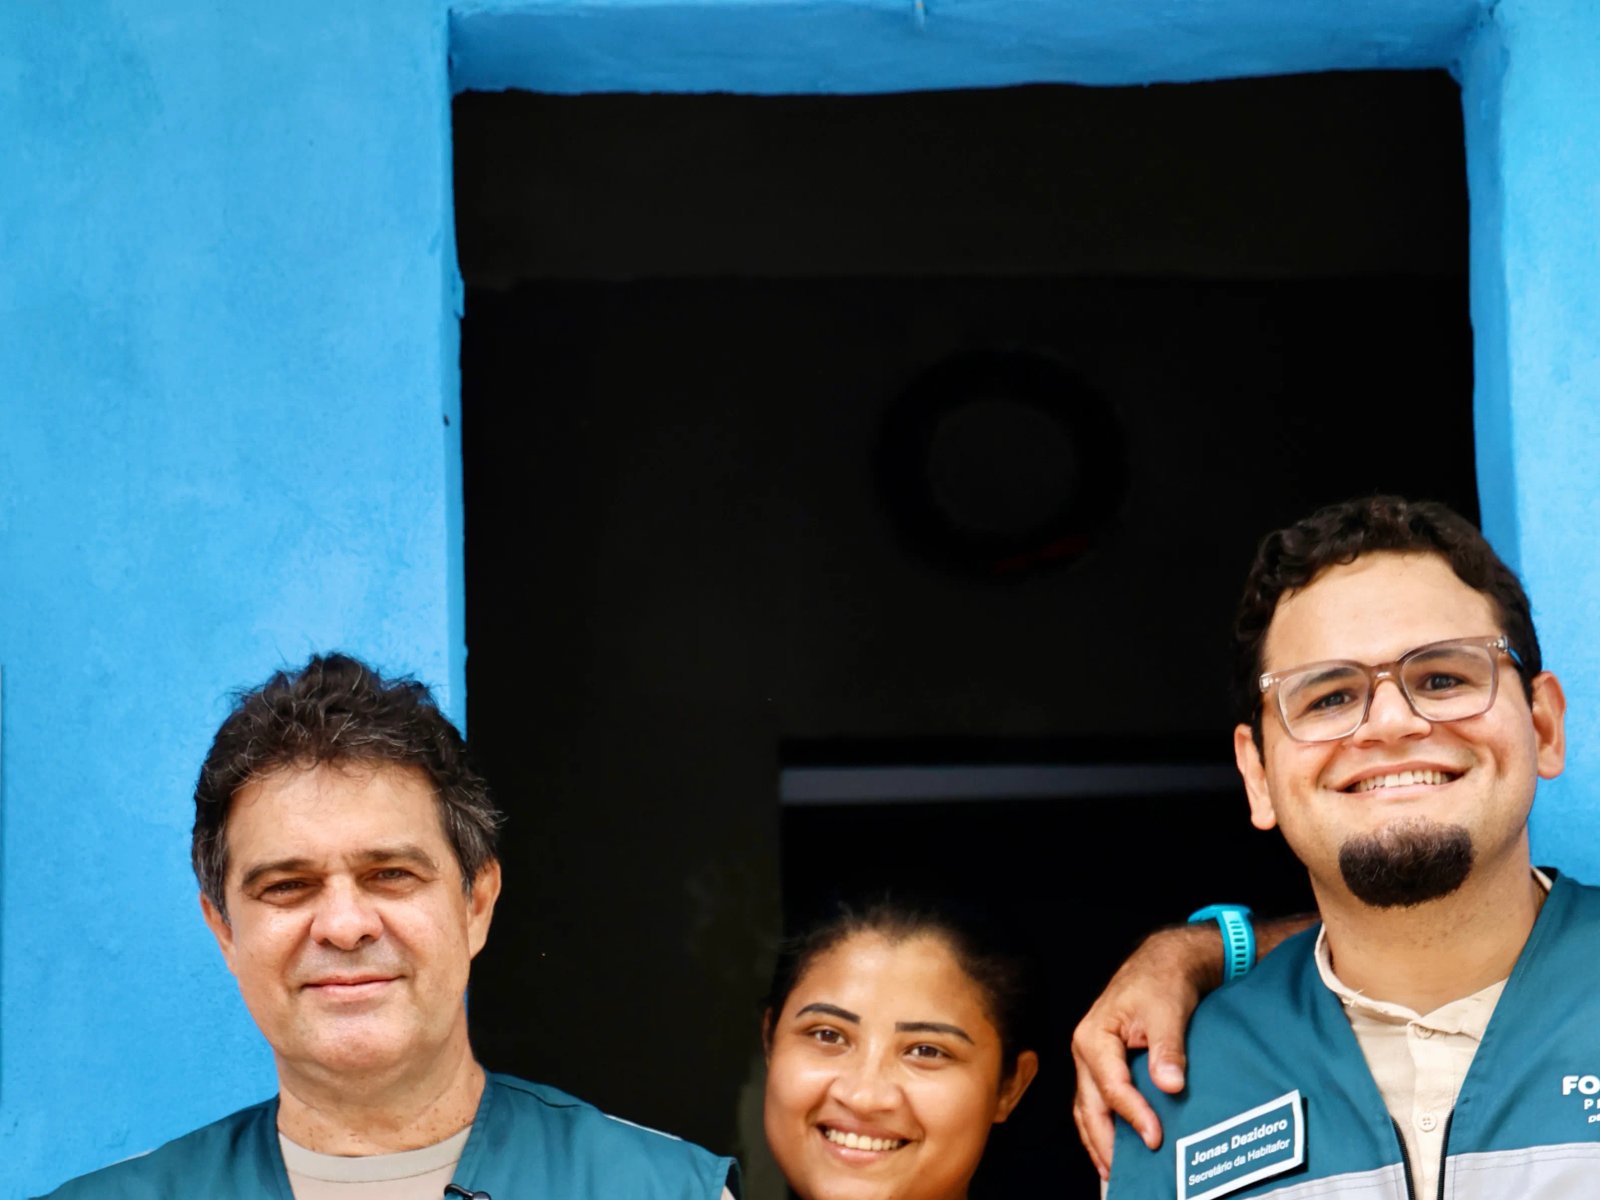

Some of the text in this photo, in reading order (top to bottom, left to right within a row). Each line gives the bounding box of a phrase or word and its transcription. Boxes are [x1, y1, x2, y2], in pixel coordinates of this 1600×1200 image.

[1188, 1139, 1291, 1185] Secretário da Habitafor
[1191, 1119, 1288, 1165] Jonas Dezidoro
